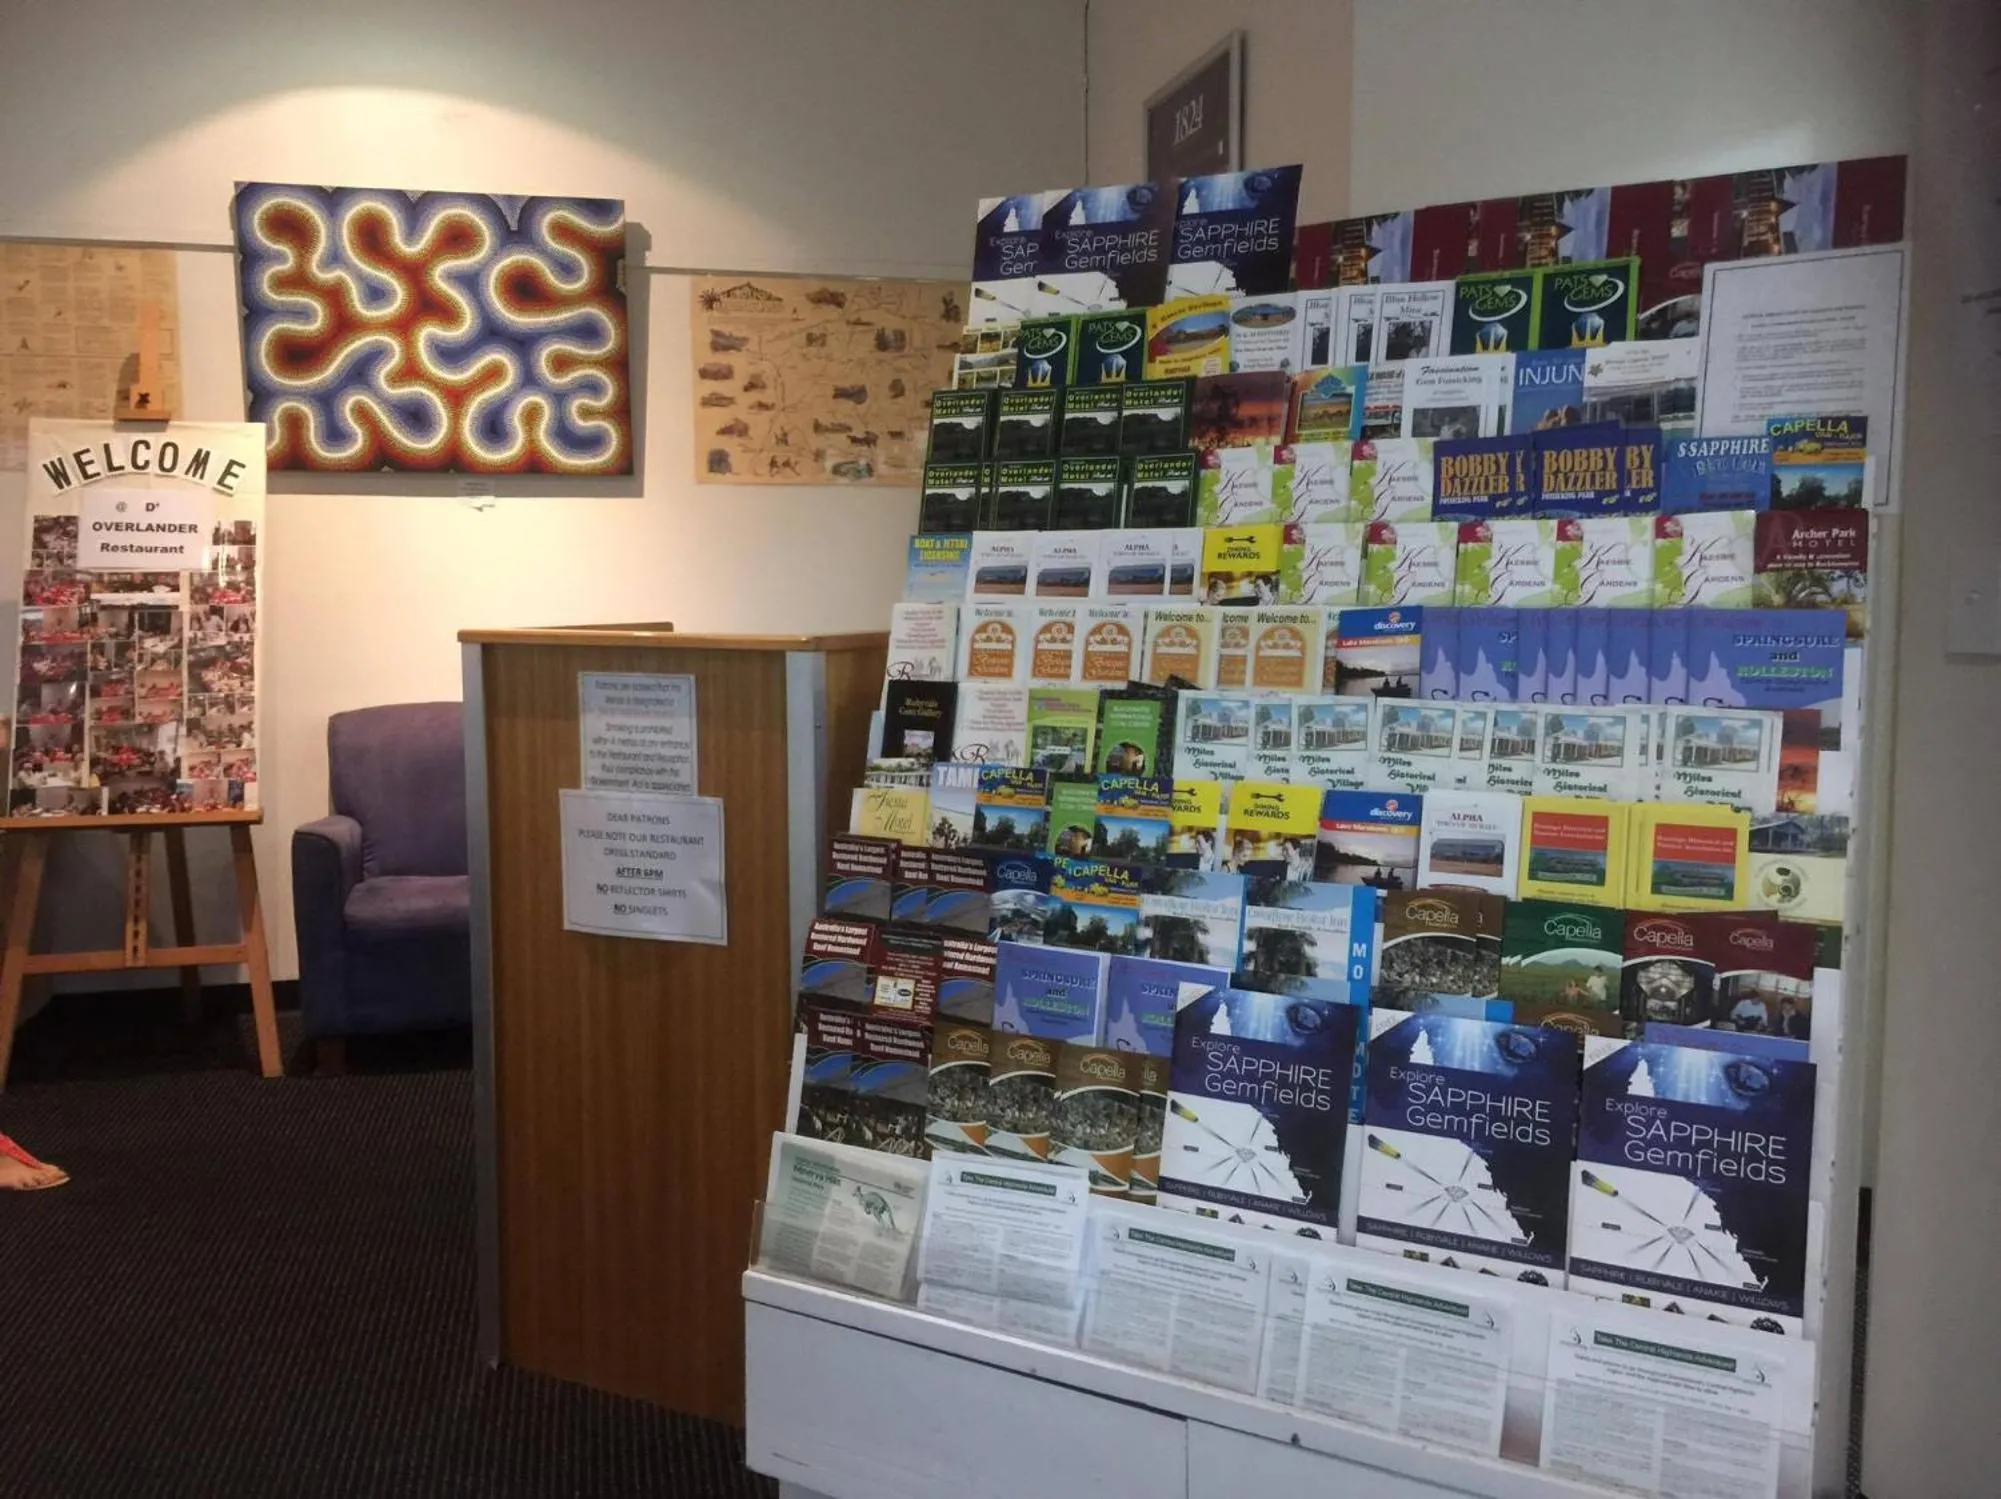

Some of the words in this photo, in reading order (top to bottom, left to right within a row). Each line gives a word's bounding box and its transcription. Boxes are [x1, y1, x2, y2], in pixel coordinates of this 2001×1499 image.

[1179, 218, 1281, 244] SAPPHIRE
[1067, 230, 1160, 254] SAPPHIRE
[1177, 236, 1279, 259] Gemfields
[1065, 249, 1158, 270] Gemfields
[1770, 418, 1849, 437] CAPELLA
[43, 439, 246, 491] WELCOME
[1439, 453, 1510, 475] BOBBY
[1542, 447, 1618, 470] BOBBY
[1440, 474, 1511, 497] DAZZLER
[1542, 469, 1617, 493] DAZZLER
[92, 521, 199, 535] OVERLANDER
[1792, 528, 1828, 540] Archer
[1831, 528, 1857, 539] Park
[99, 542, 185, 555] Restaurant
[1216, 552, 1261, 561] REWARDS
[1155, 611, 1194, 623] Welcome
[1257, 612, 1299, 624] Welcome
[1373, 621, 1416, 632] discovery
[1770, 651, 1800, 663] and
[981, 766, 1034, 783] CAPELLA
[1101, 777, 1159, 793] CAPELLA
[1171, 803, 1202, 814] WARDS
[1243, 808, 1291, 820] REWARDS
[1369, 808, 1414, 822] discovery
[1451, 812, 1484, 823] ALPHA
[607, 812, 628, 822] DEAR
[630, 813, 671, 825] PATRONS
[606, 832, 626, 841] NOTE
[629, 833, 648, 843] OUR
[650, 835, 704, 846] RESTAURANT
[630, 848, 677, 860] STANDARD
[616, 867, 642, 878] AFTER
[997, 866, 1038, 885] Capella
[1073, 864, 1130, 881] CAPELLA
[596, 883, 609, 895] NO
[614, 904, 627, 915] NO
[1405, 905, 1459, 925] Capella
[1544, 919, 1602, 940] Capella
[1633, 926, 1694, 948] Capella
[1728, 932, 1774, 949] Capella
[947, 1036, 990, 1054] Capella
[1006, 1043, 1051, 1063] Capella
[1191, 1036, 1241, 1055] Explore
[1080, 1060, 1127, 1079] Capella
[1206, 1051, 1332, 1091] SAPPHIRE
[1389, 1066, 1446, 1086] Explore
[1205, 1073, 1332, 1112] Gemfields
[1407, 1082, 1552, 1123] SAPPHIRE
[1604, 1098, 1668, 1119] Explore
[1406, 1105, 1551, 1145] Gemfields
[1625, 1116, 1787, 1160] SAPPHIRE
[1624, 1140, 1787, 1184] Gemfields
